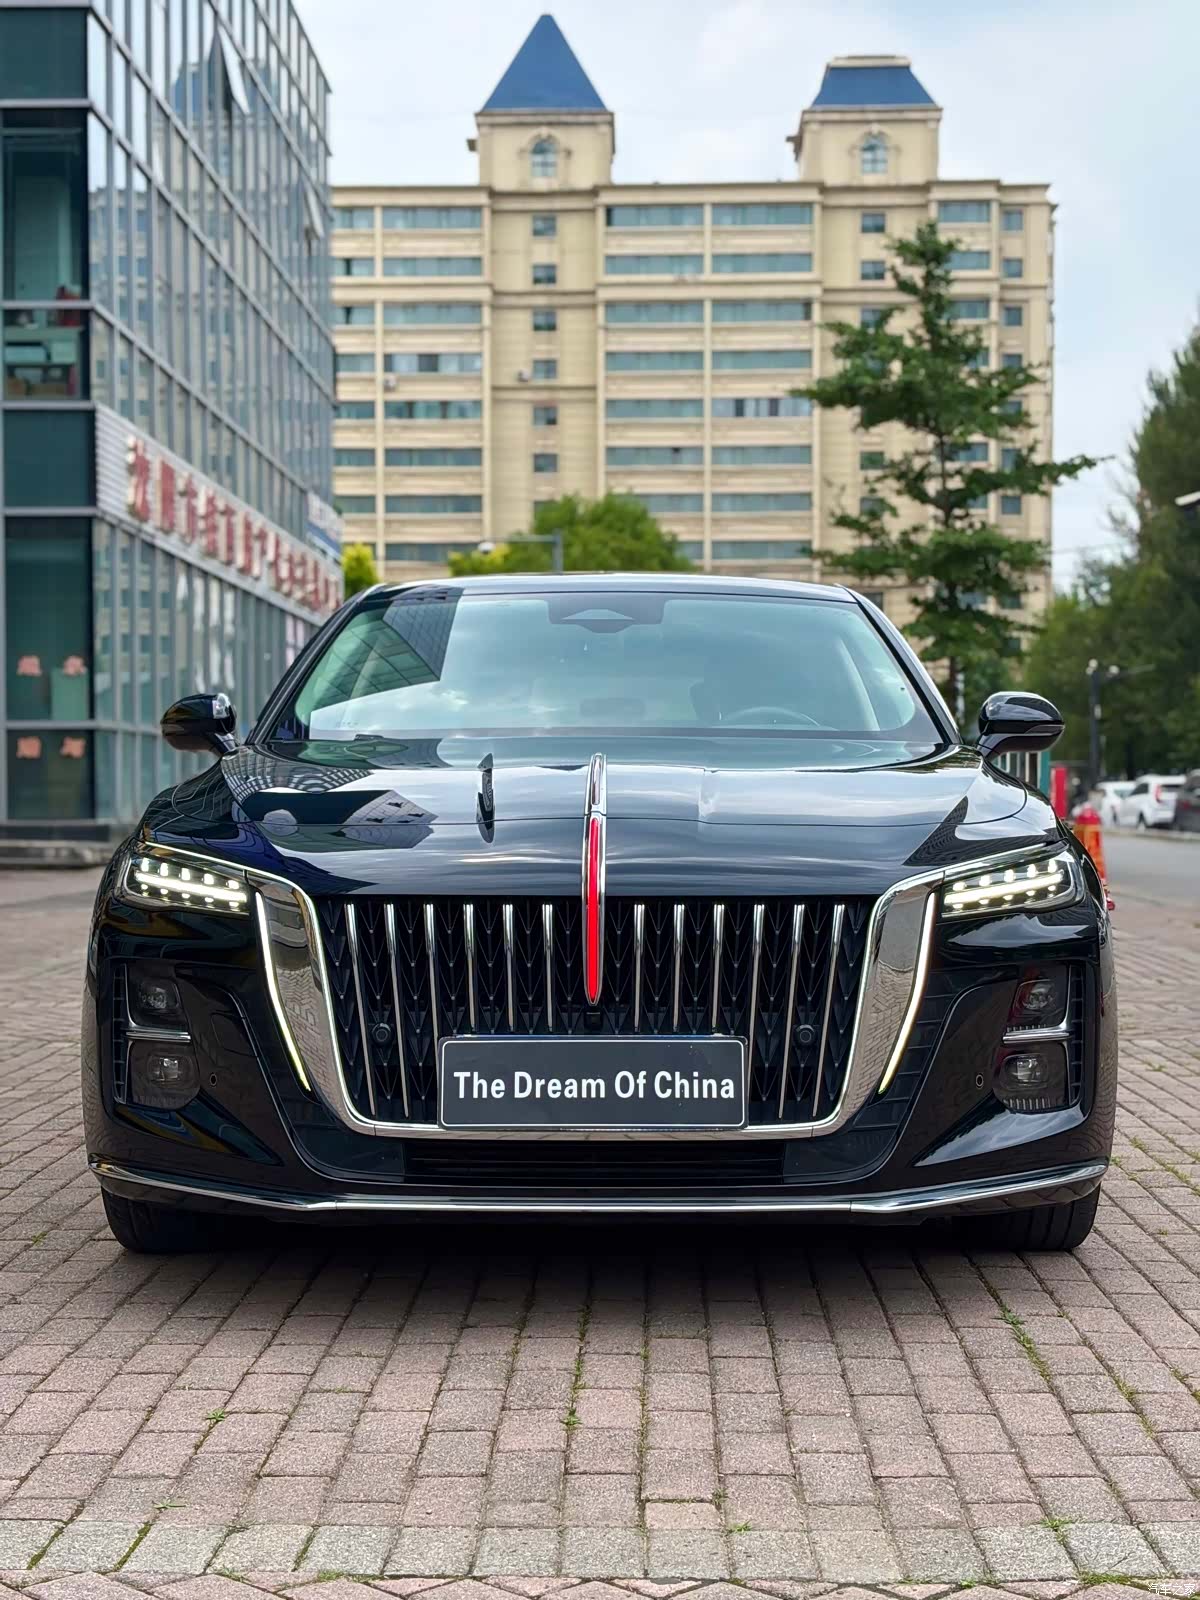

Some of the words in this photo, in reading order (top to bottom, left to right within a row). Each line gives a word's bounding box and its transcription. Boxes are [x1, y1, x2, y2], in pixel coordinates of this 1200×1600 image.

[453, 1071, 505, 1099] The
[514, 1071, 606, 1099] Dream
[614, 1070, 647, 1099] Of
[654, 1070, 735, 1099] China
